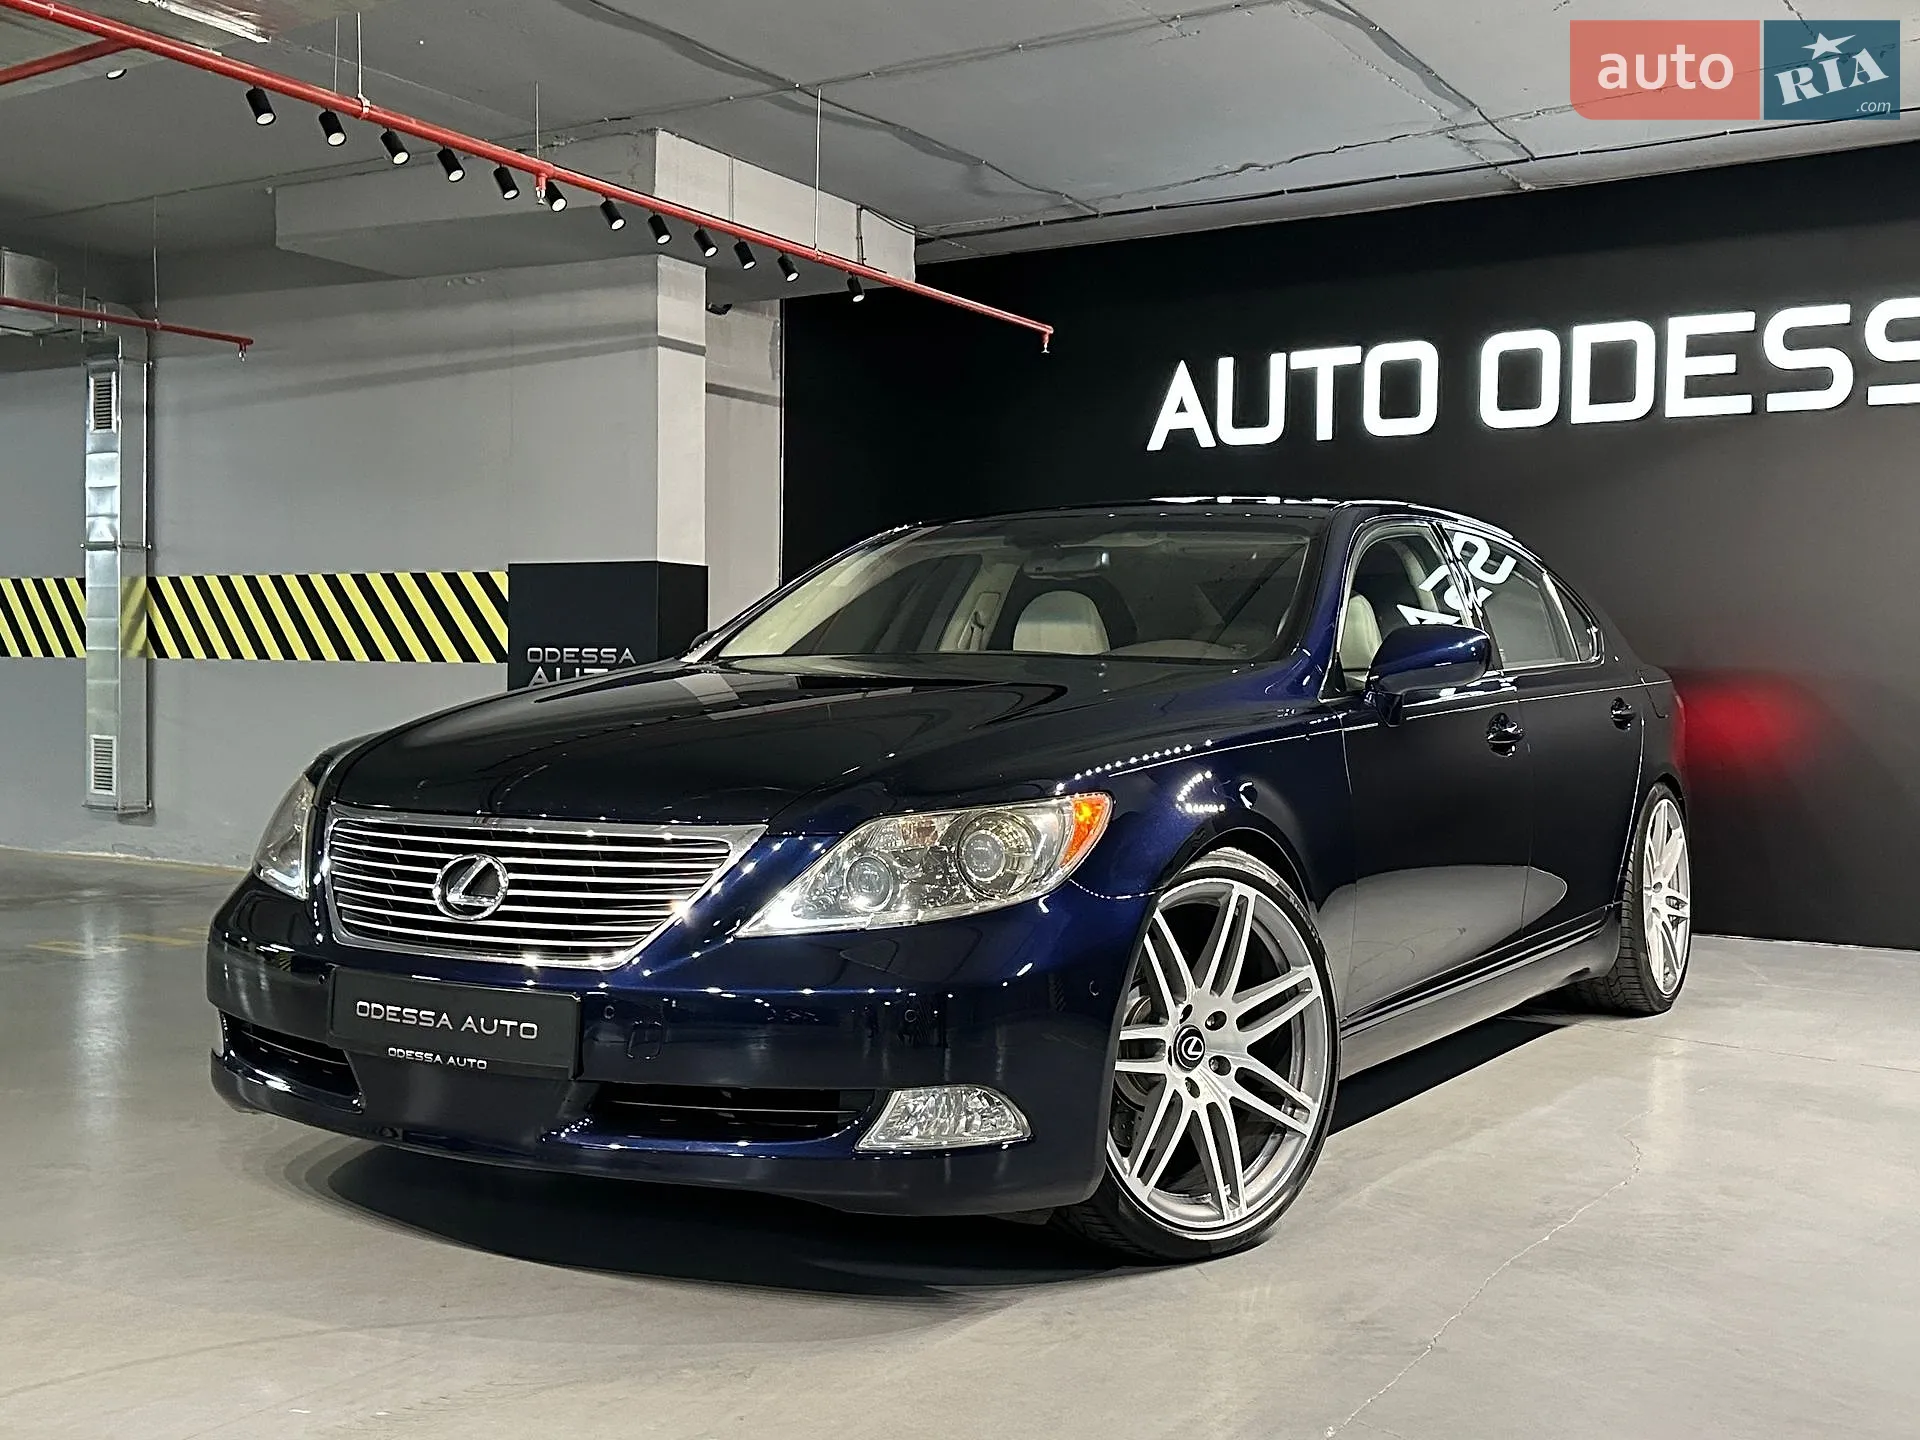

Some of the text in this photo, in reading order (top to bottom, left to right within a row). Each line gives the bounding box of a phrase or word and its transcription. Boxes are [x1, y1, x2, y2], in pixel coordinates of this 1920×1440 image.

[1146, 297, 1920, 451] AUTO ODESS
[527, 647, 636, 664] ODESSA
[356, 1000, 538, 1040] ODESSA AUTO
[387, 1047, 488, 1070] ODESSA AUTO
